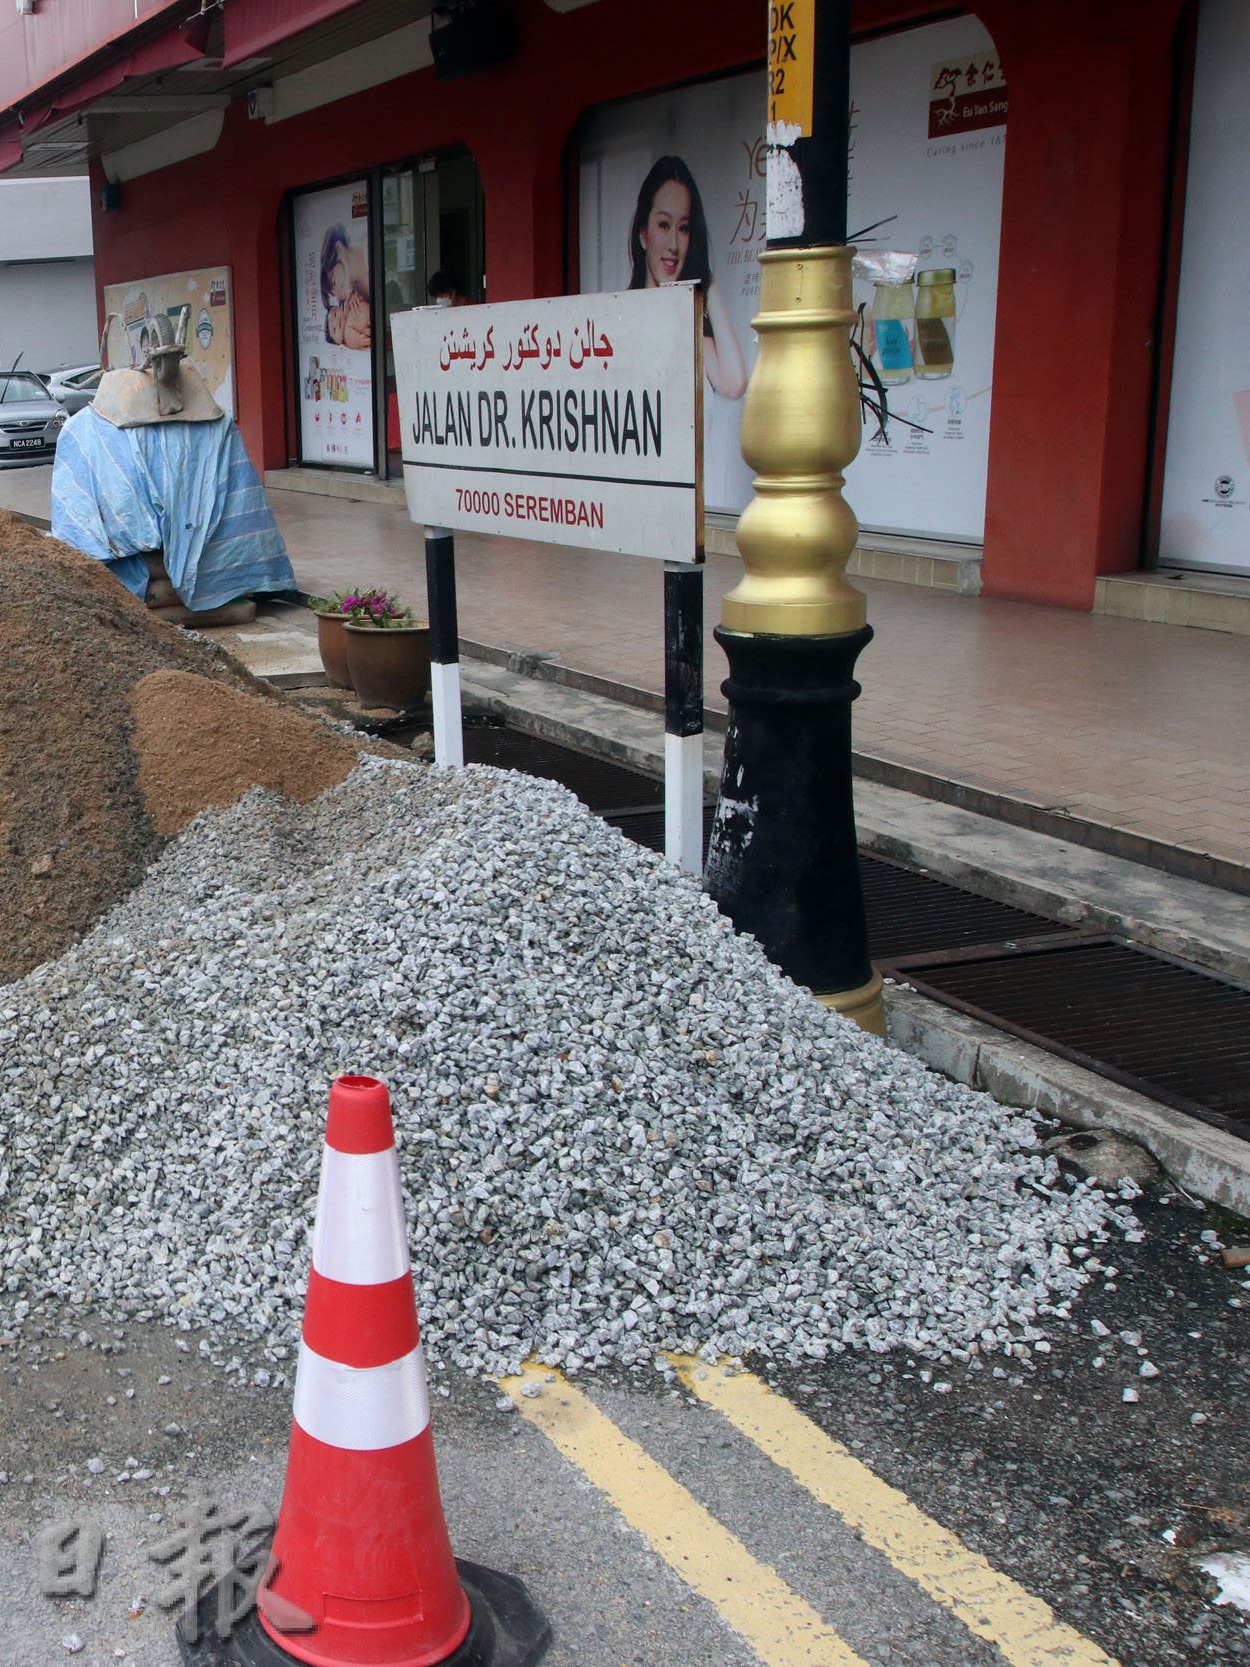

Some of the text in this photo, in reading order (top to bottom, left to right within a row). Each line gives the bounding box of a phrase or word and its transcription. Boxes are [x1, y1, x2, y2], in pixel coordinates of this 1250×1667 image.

[569, 318, 614, 370] جالن
[412, 389, 662, 458] JALAN DR. KRISHNAN
[455, 488, 604, 529] 70000 SEREMBAN
